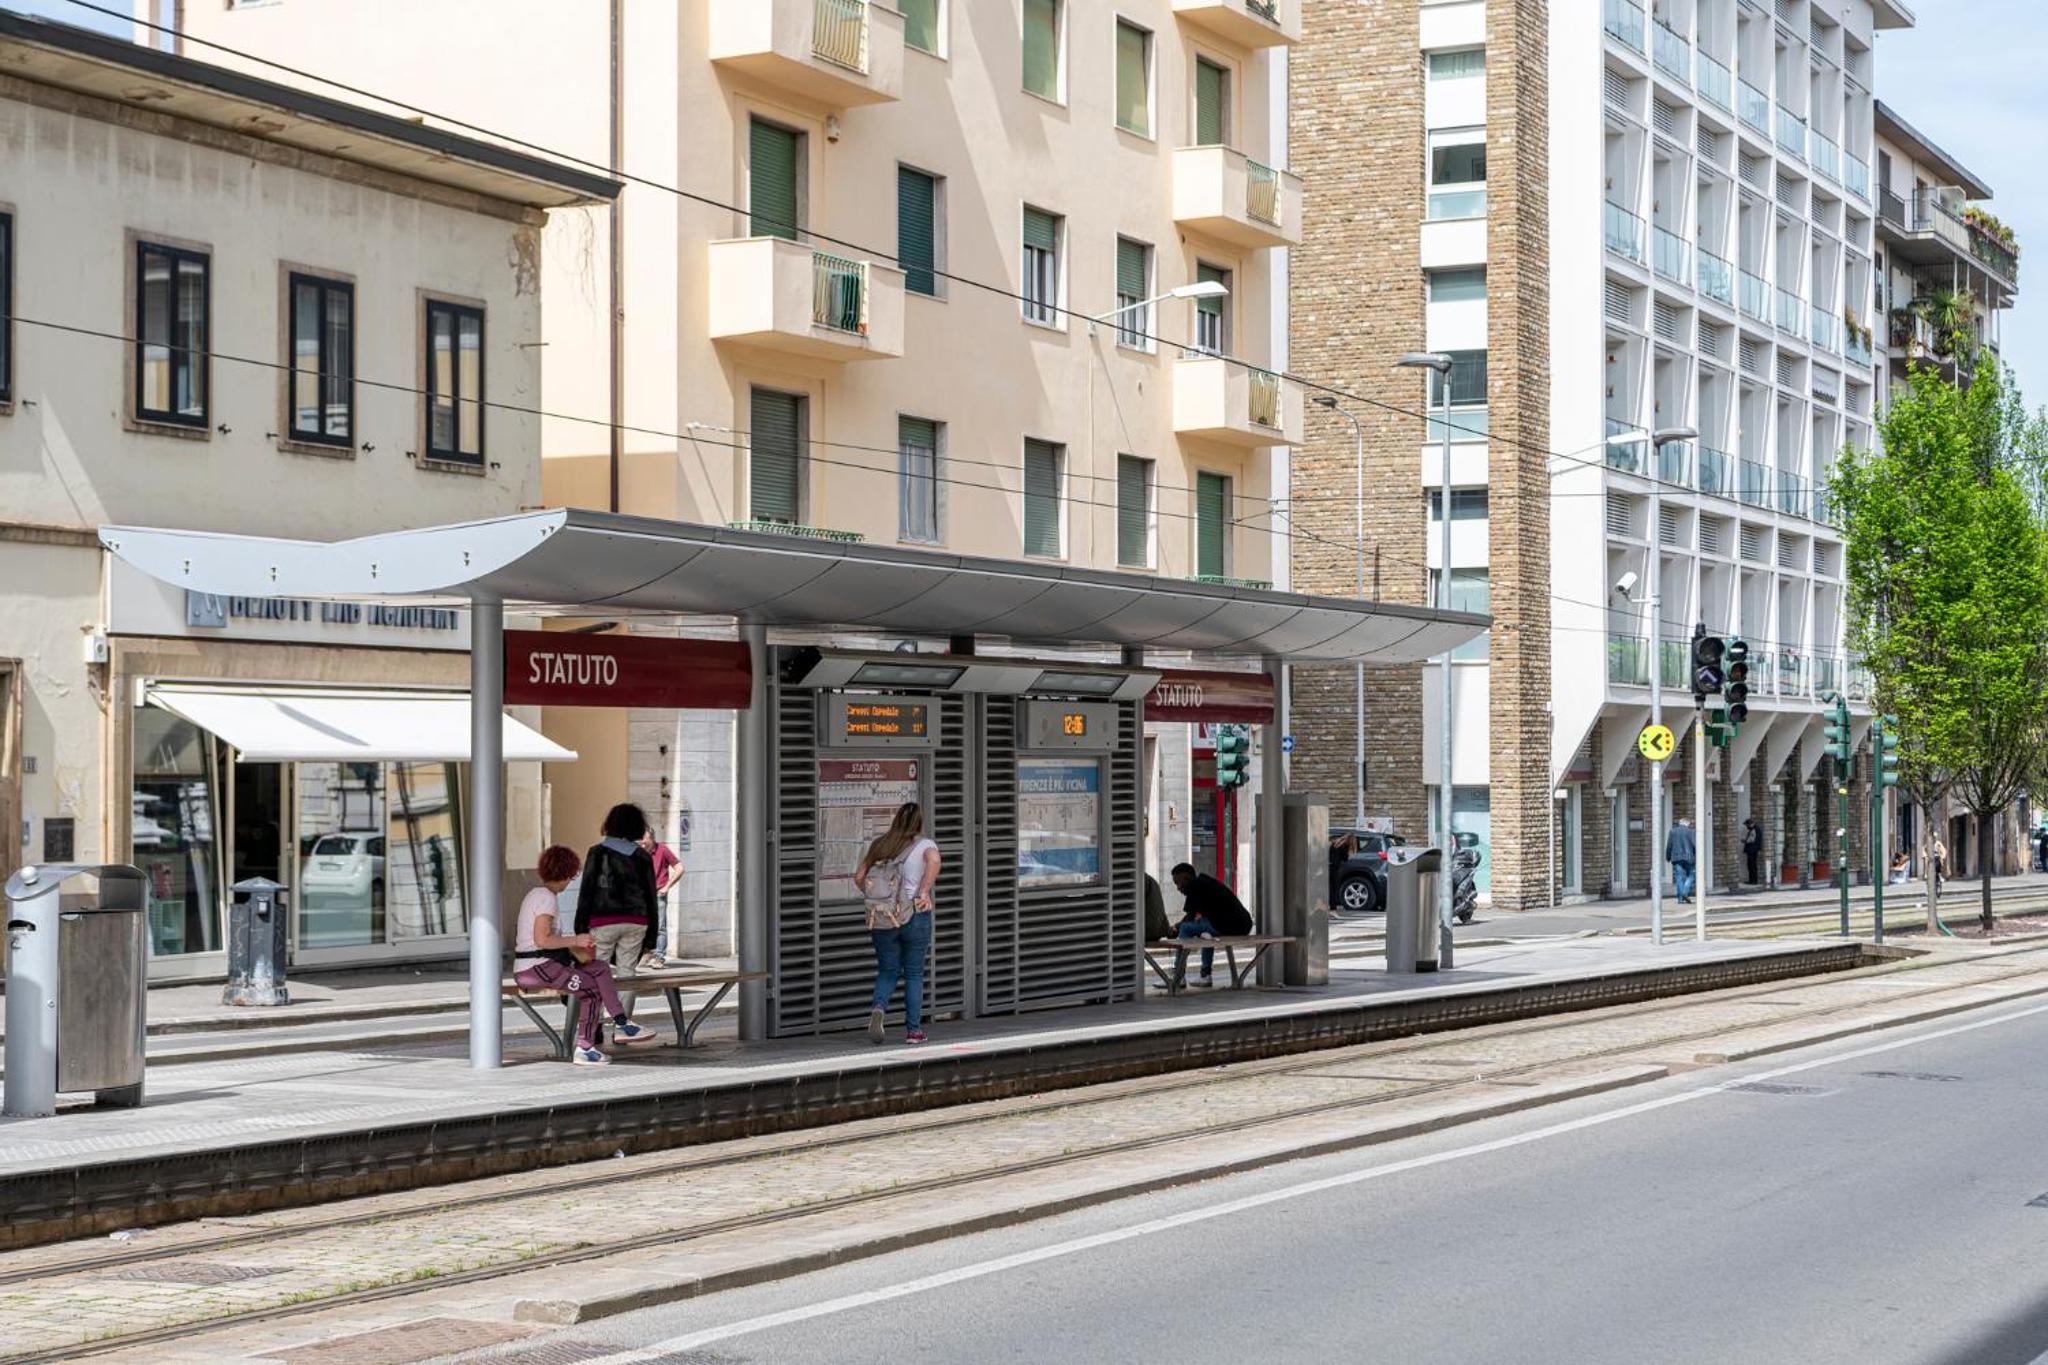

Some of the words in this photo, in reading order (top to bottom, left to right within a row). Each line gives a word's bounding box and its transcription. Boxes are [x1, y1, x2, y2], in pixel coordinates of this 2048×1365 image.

[528, 652, 618, 685] STATUTO
[1155, 684, 1203, 707] STATUTO
[852, 763, 880, 772] STATUTO
